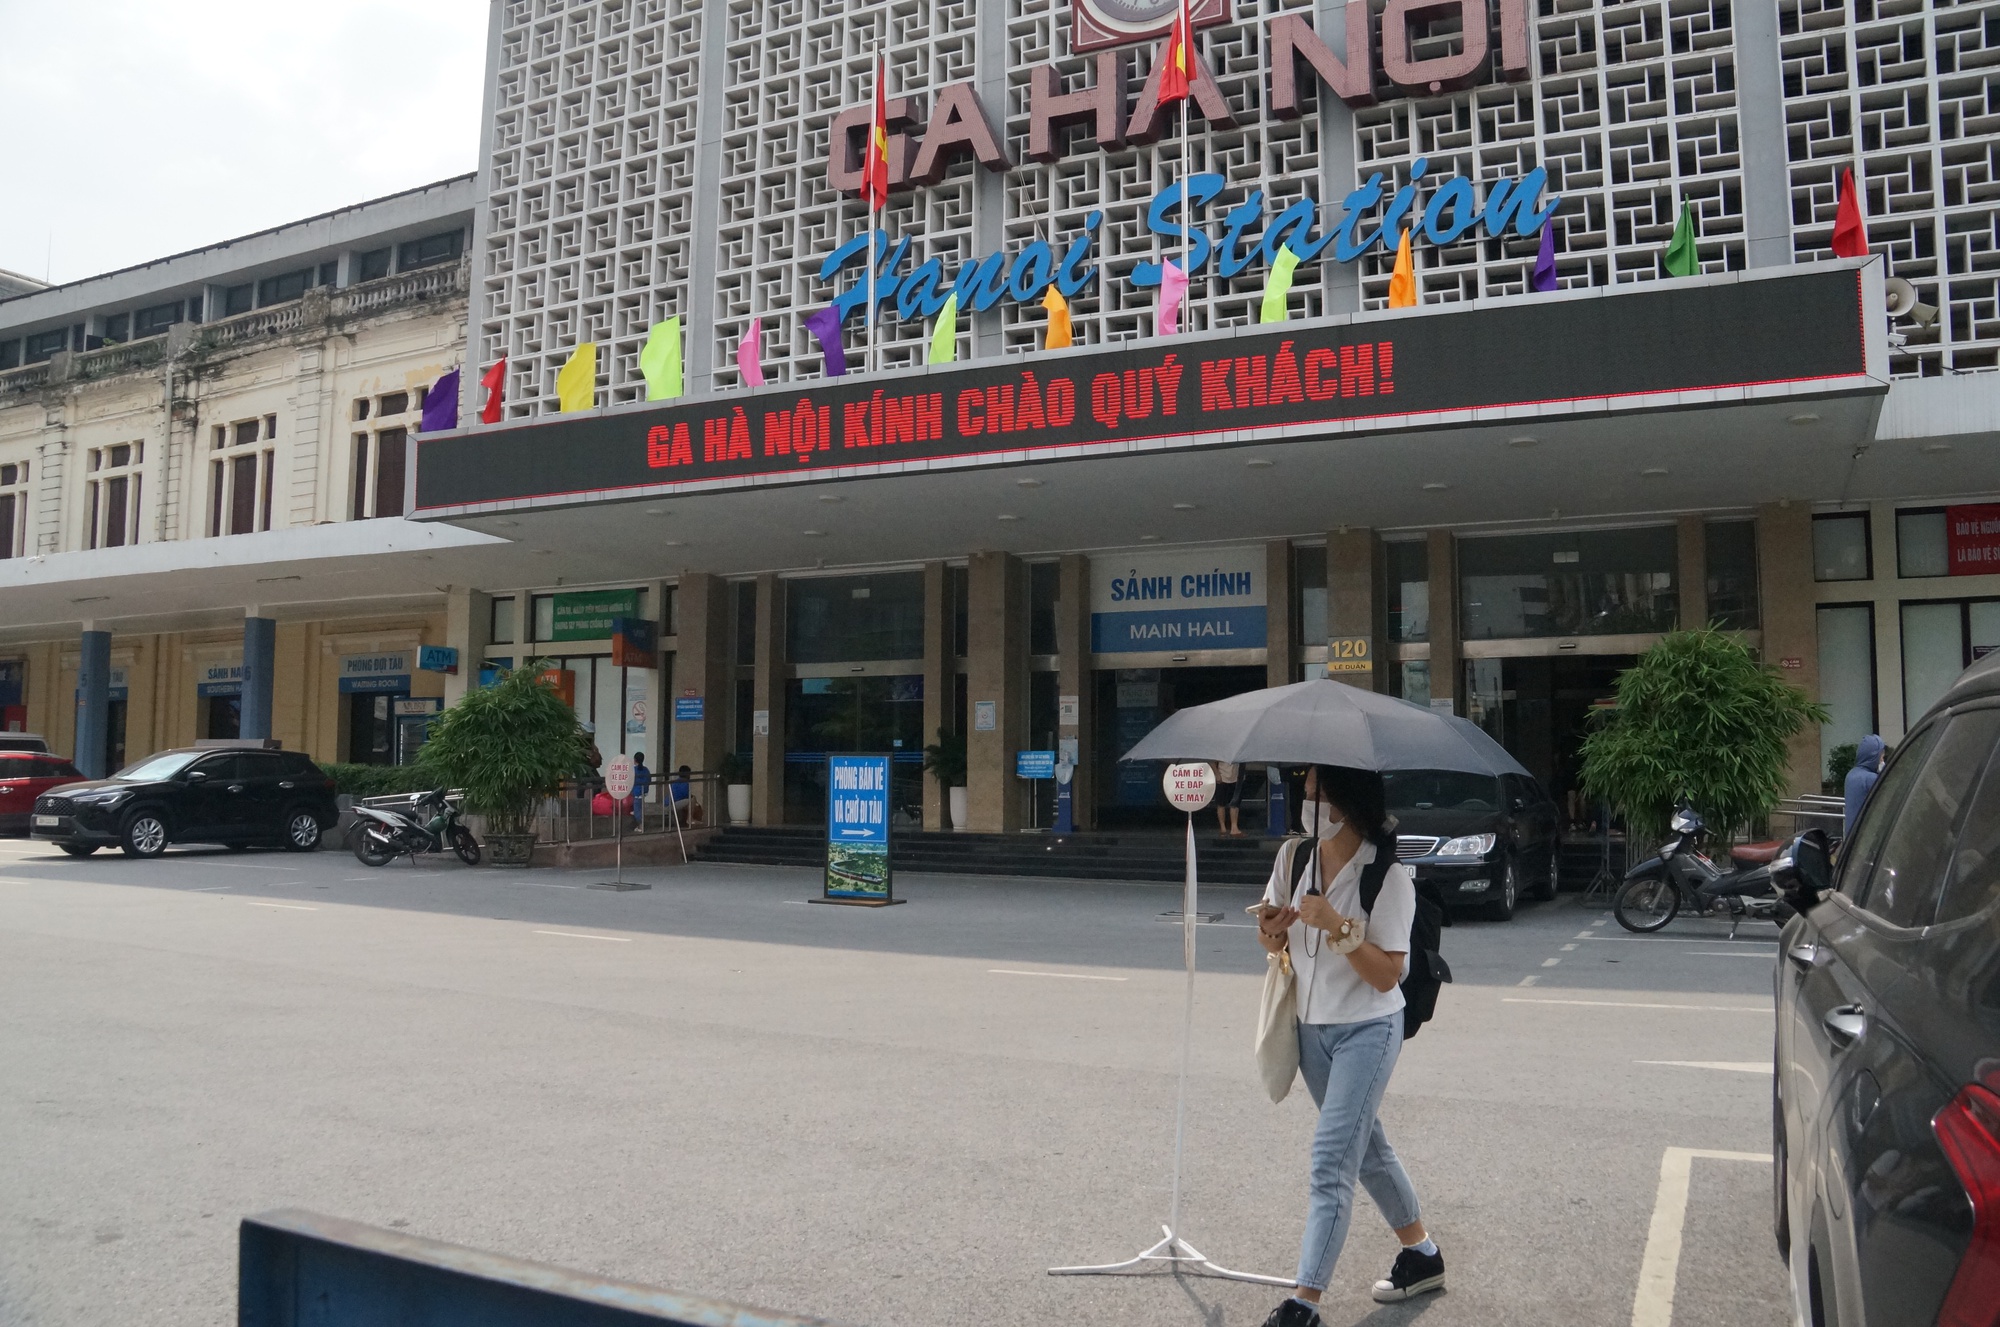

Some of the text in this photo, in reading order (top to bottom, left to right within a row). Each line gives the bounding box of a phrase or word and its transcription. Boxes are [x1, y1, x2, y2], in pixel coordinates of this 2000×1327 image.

[829, 82, 1009, 200] GA
[818, 156, 1563, 326] Hanoi Station
[646, 340, 1395, 469] GA HÀ NỘI KÍNH CHÀO QUÝ KHÁCH!
[1111, 567, 1252, 602] SẢNH CHÍNH
[1130, 620, 1234, 640] MAIN HALL
[426, 649, 452, 664] ATM
[1331, 639, 1368, 658] 120
[208, 664, 228, 680] SẢNH
[346, 655, 373, 673] PHÒNG
[388, 654, 404, 670] TÀU
[243, 666, 252, 681] 6
[540, 674, 557, 684] ATM
[351, 679, 400, 689] WAITING ROOM
[834, 760, 884, 790] PHÒNG BÁN VÉ
[1175, 781, 1185, 789] XE
[1174, 794, 1184, 802] XE
[834, 794, 883, 824] VÀ CHỜ ĐI TÀU
